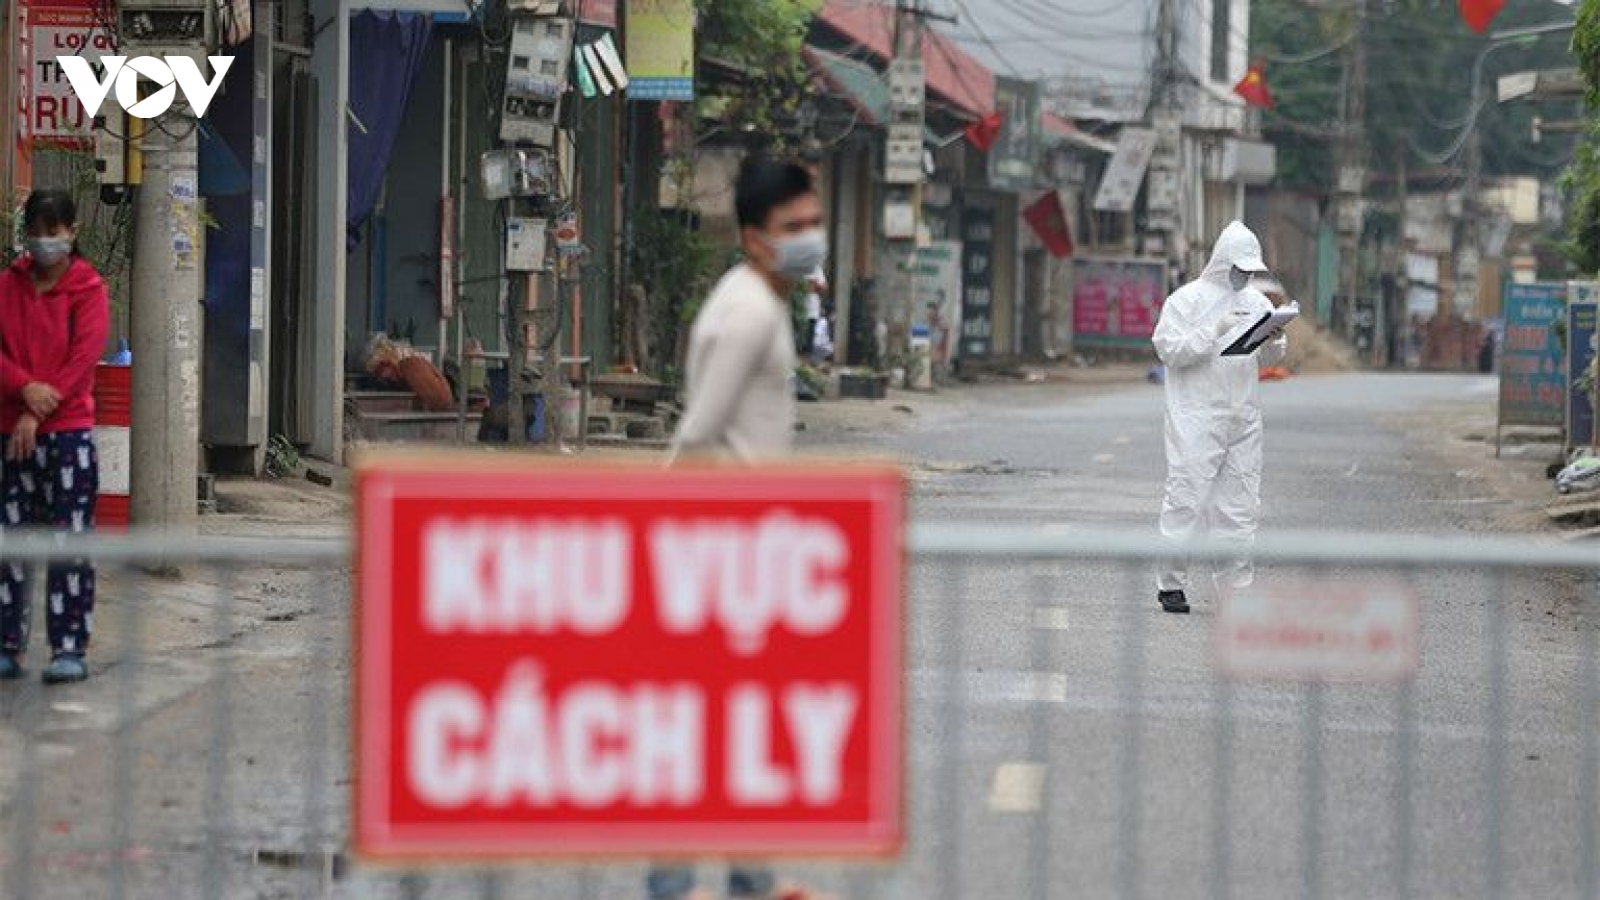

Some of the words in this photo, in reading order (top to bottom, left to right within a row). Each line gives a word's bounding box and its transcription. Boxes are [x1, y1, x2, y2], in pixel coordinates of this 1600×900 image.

[421, 516, 633, 634] KHU
[647, 508, 851, 656] VỰC
[407, 658, 708, 809] CÁCH
[725, 681, 859, 808] LY
